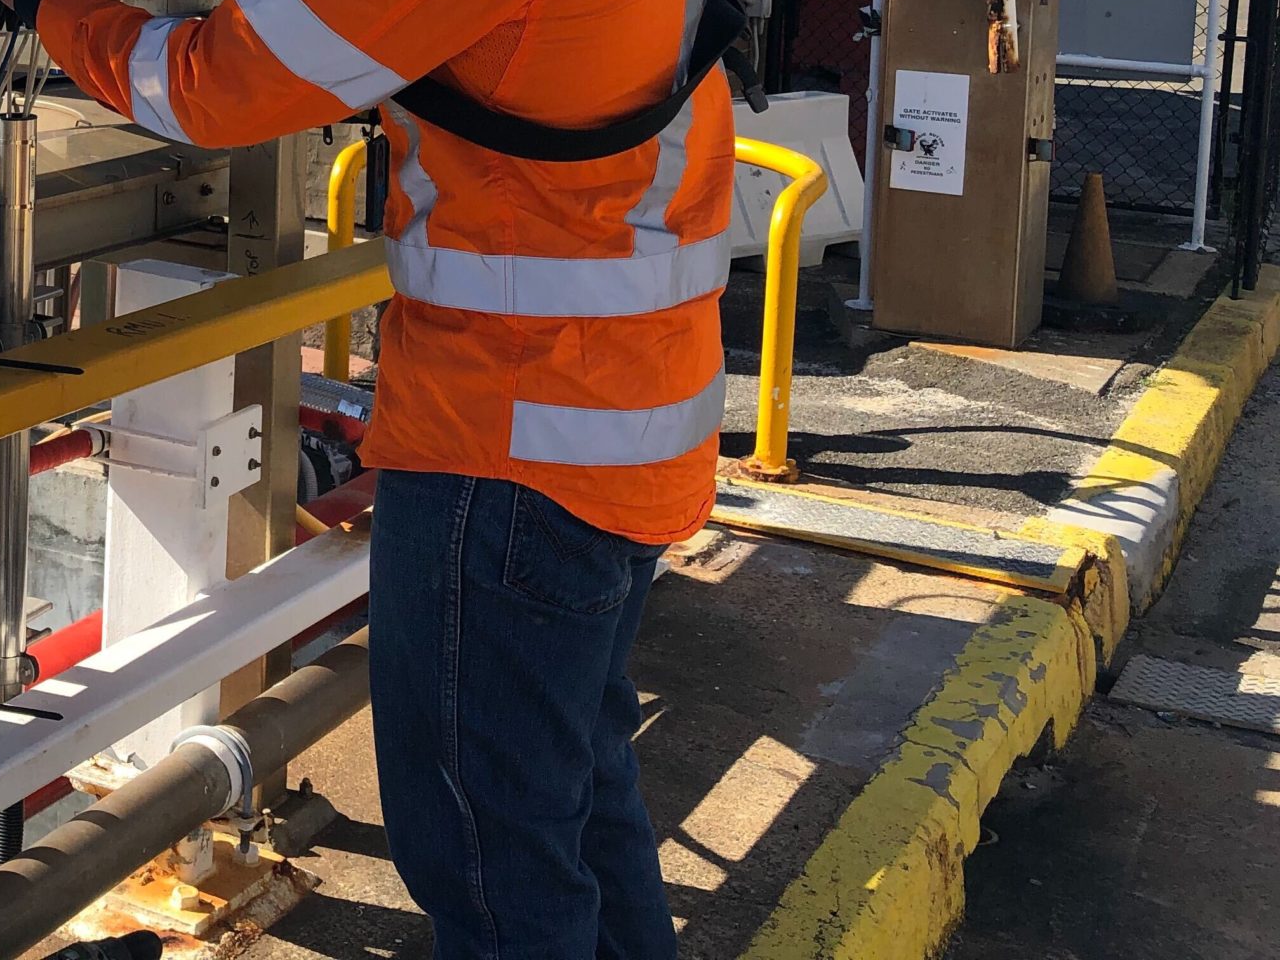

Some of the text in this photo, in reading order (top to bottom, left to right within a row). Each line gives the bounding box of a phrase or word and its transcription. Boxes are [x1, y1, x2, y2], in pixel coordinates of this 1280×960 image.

[899, 113, 961, 124] WITHOUT WARNING
[922, 110, 958, 118] ACTIVATES
[245, 249, 260, 277] TOP
